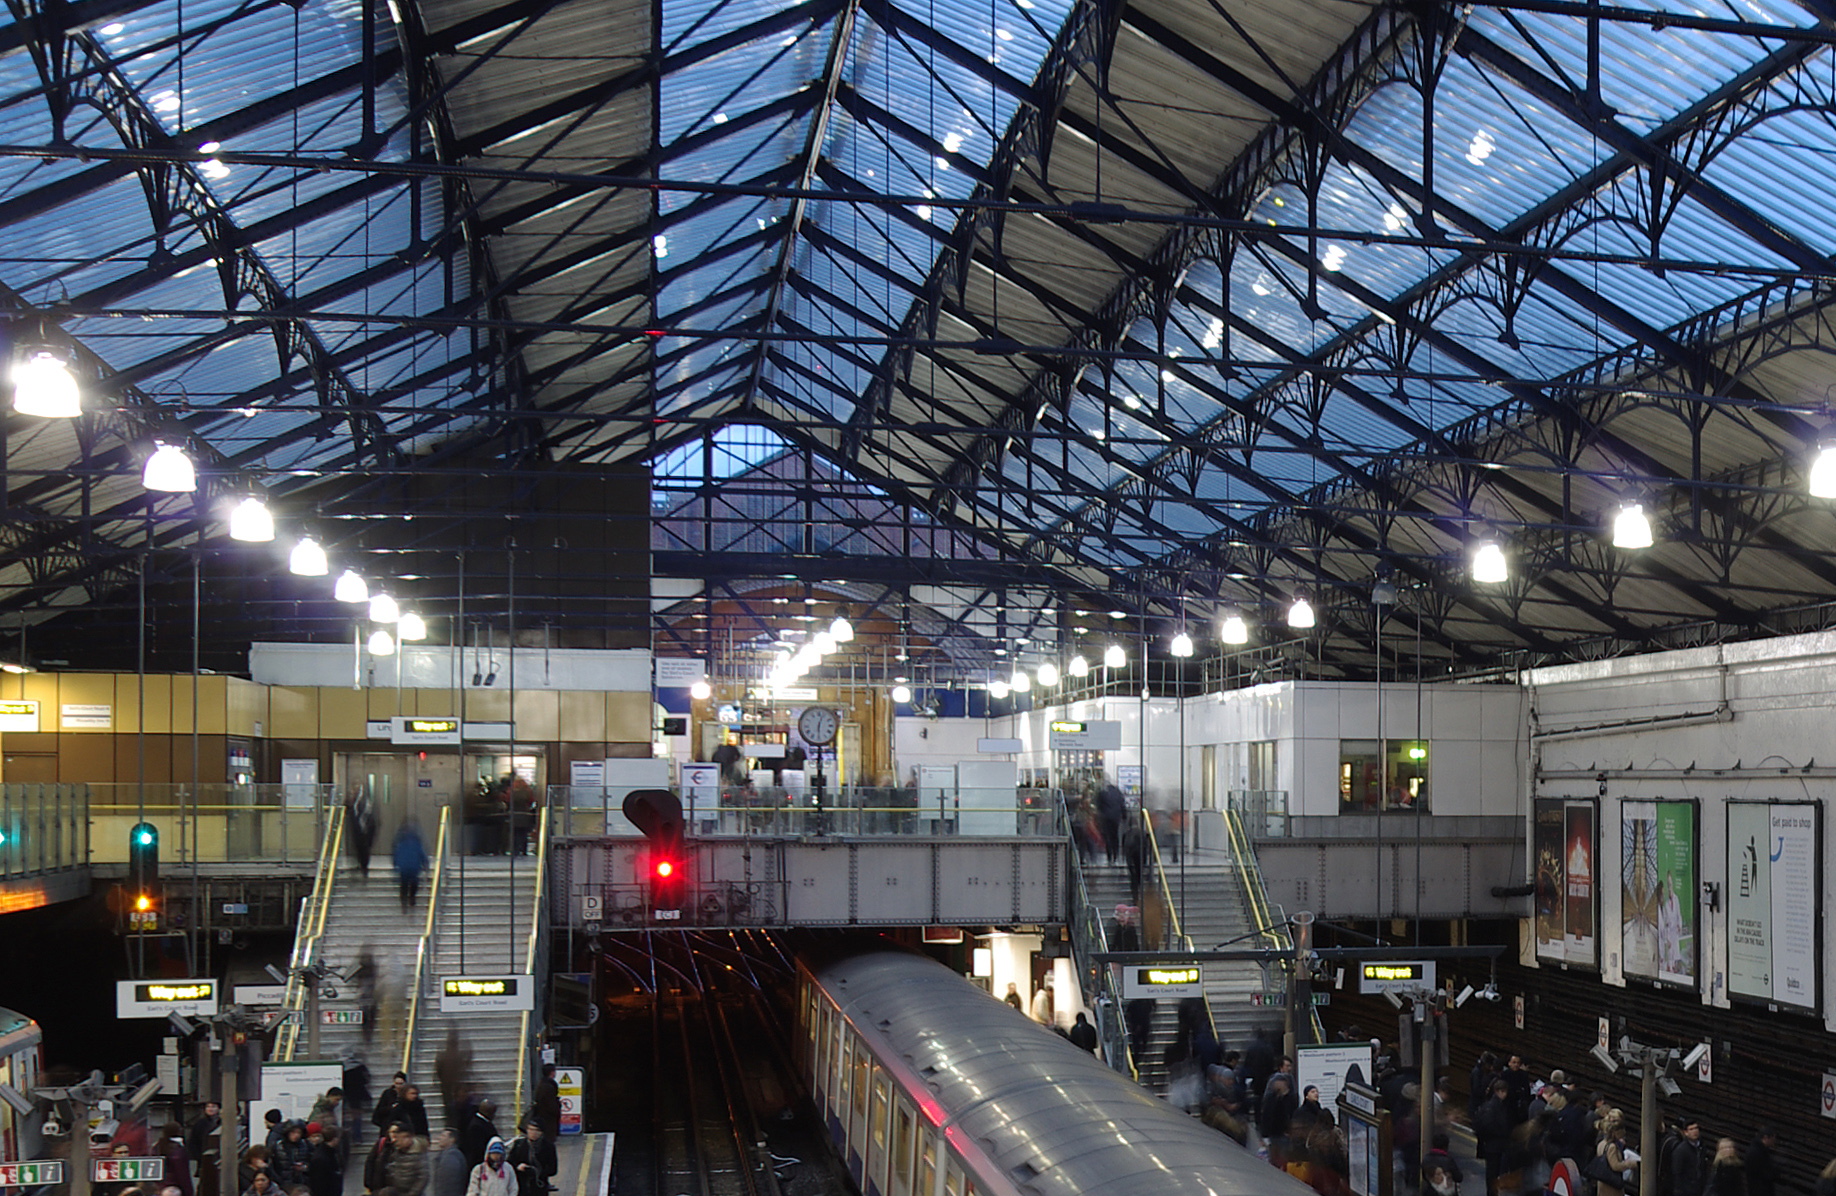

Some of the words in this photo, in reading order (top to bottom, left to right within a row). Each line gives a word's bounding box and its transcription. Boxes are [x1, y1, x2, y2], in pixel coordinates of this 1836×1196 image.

[1772, 817, 1780, 827] Get
[1782, 818, 1792, 828] paid
[1793, 818, 1797, 828] to
[1799, 818, 1810, 828] shop
[586, 898, 598, 908] D
[458, 981, 484, 996] Way
